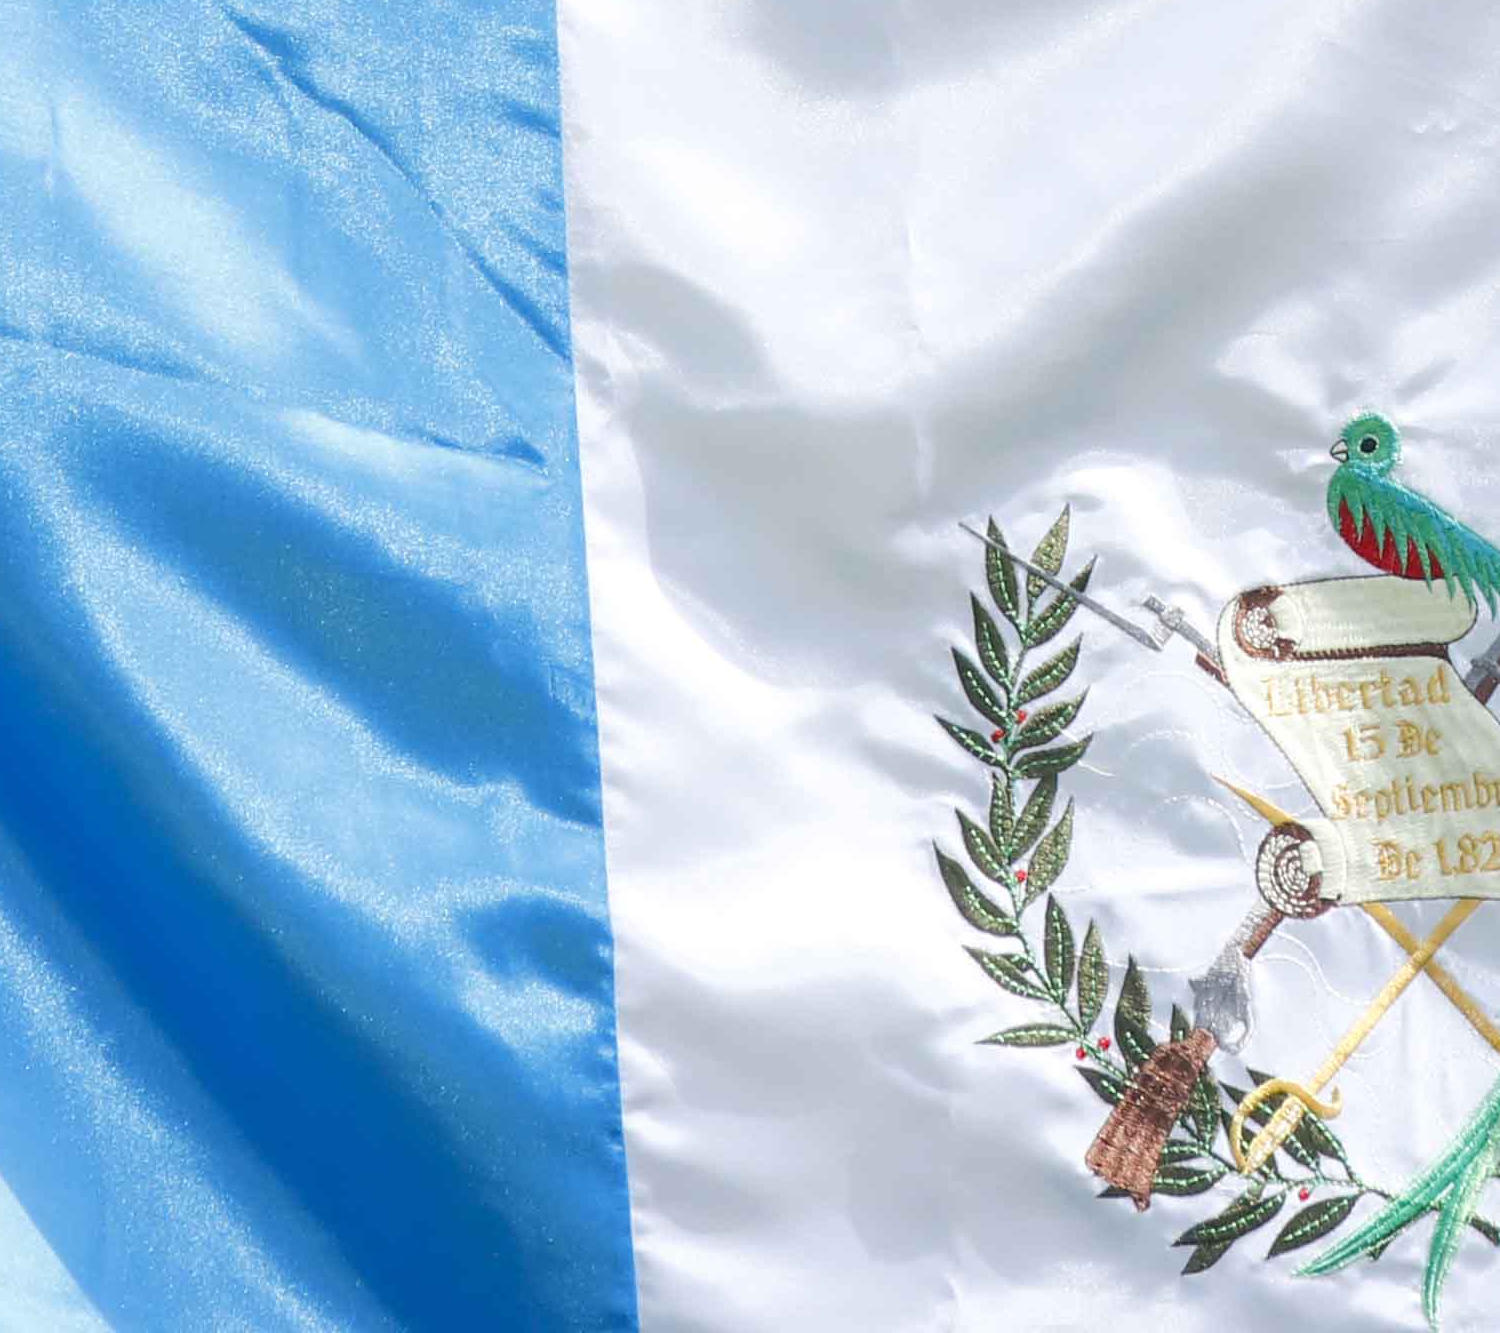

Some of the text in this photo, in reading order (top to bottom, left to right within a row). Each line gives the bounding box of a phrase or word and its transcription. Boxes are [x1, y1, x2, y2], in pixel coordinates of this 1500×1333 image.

[1260, 663, 1451, 717] Libertad
[1342, 719, 1443, 761] 15 De
[1372, 837, 1422, 881] De
